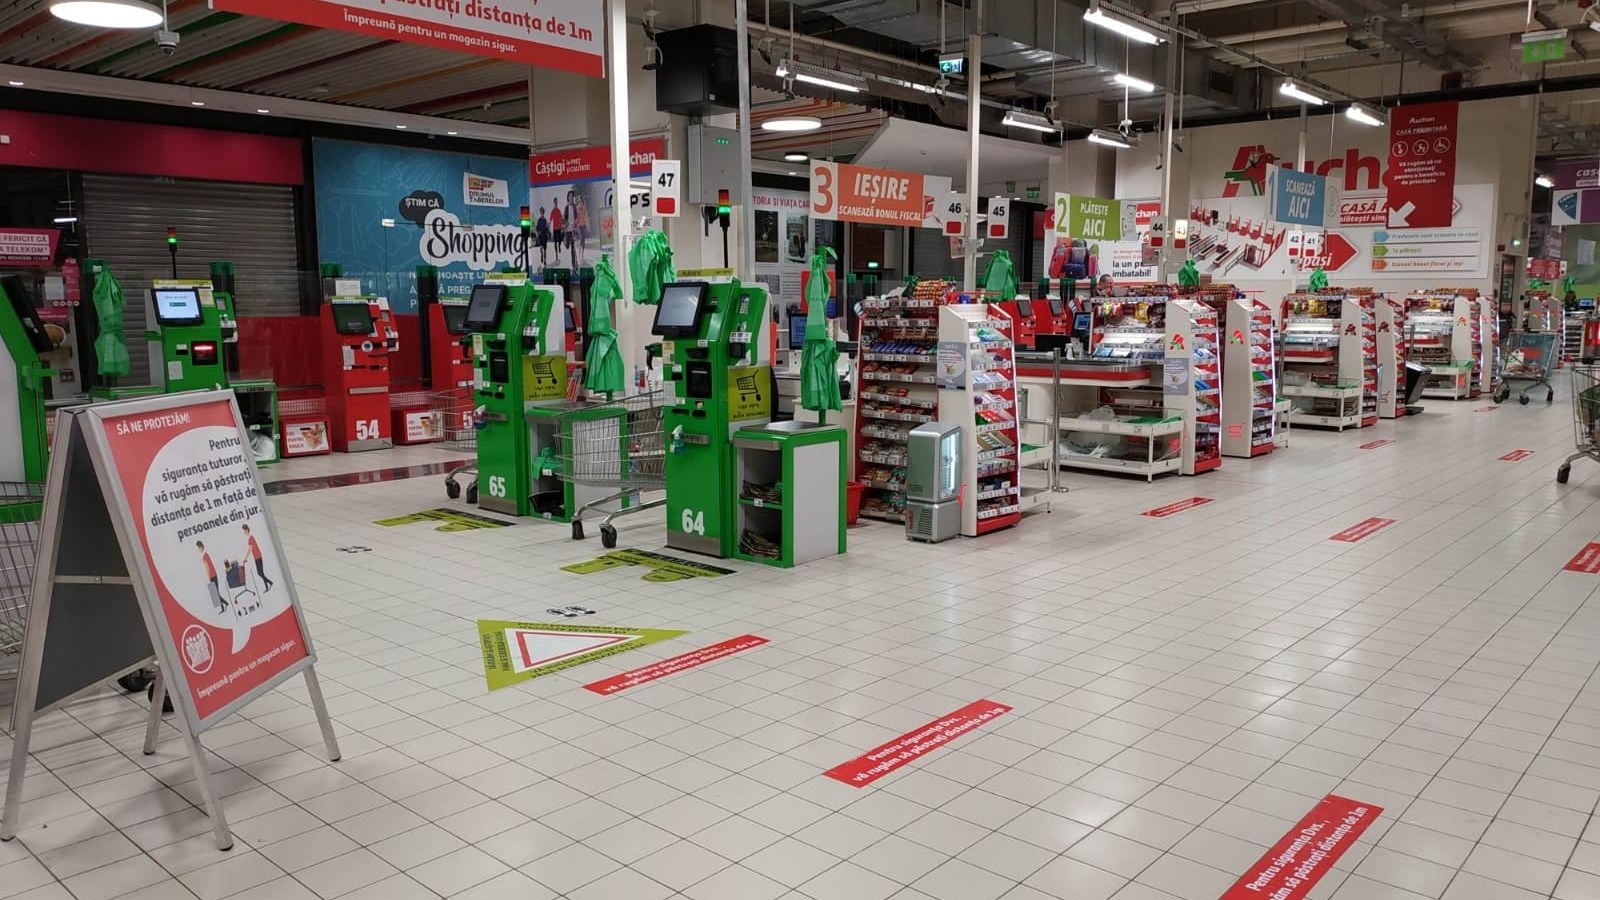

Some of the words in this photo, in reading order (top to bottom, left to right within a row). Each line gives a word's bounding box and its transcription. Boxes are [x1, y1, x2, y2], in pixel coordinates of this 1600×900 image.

[344, 8, 396, 30] Împreună
[398, 22, 432, 37] pentru
[434, 30, 447, 40] un
[449, 33, 490, 48] magazin
[491, 39, 517, 53] sigur.
[465, 0, 542, 34] distanța
[546, 16, 565, 34] de
[568, 21, 592, 41] 1m
[535, 158, 566, 178] Câștigi
[629, 151, 656, 166] chan
[658, 173, 675, 188] 47
[813, 166, 833, 214] 3
[854, 172, 909, 204] IEȘIRE
[1285, 178, 1316, 198] SCANEAZĂ
[405, 197, 426, 208] ȘTIM
[427, 198, 440, 208] CĂ
[839, 204, 875, 218] SCANEAZĂ
[875, 208, 898, 219] BONUL
[898, 211, 922, 221] FISCAL
[949, 204, 962, 215] 46
[992, 205, 1006, 217] 45
[1080, 200, 1109, 216] PLĂTEȘTE
[1287, 197, 1310, 218] AICI
[1340, 199, 1377, 213] CASĂ
[1056, 197, 1067, 233] 2
[1135, 209, 1159, 219] chan
[1082, 218, 1106, 237] AICI
[1152, 222, 1163, 232] 44
[427, 217, 526, 270] Shopping
[1290, 235, 1300, 243] 42
[1112, 260, 1120, 268] la
[1112, 269, 1152, 277] imbatabil!
[116, 422, 129, 435] SĂ
[130, 420, 143, 432] NE
[144, 412, 191, 431] PROTEJĂM!
[355, 418, 380, 441] 54
[209, 436, 241, 451] Pentru
[162, 464, 209, 483] siguranța
[155, 491, 168, 504] vă
[169, 484, 201, 501] rugăm
[202, 478, 213, 492] să
[214, 467, 252, 489] păstrați
[489, 475, 506, 498] 65
[151, 508, 192, 527] distanța
[193, 502, 206, 514] de
[207, 499, 214, 511] 1
[214, 500, 223, 508] m
[222, 490, 244, 506] față
[244, 486, 257, 498] de
[177, 513, 229, 542] persoanele
[229, 507, 245, 522] din
[244, 504, 263, 520] jur.
[682, 508, 705, 536] 64
[867, 743, 902, 762] Pentru
[900, 722, 943, 749] siguranța
[853, 770, 869, 782] vă
[867, 758, 901, 775] rugăm
[899, 750, 912, 761] să
[911, 733, 946, 755] păstrați
[1284, 876, 1301, 889] să
[1293, 847, 1332, 881] păstrați
[1320, 822, 1353, 853] distanța
[1344, 811, 1360, 824] de
[1355, 806, 1369, 817] 1m
[1245, 865, 1282, 892] Pentru
[1273, 831, 1313, 867] siguranța
